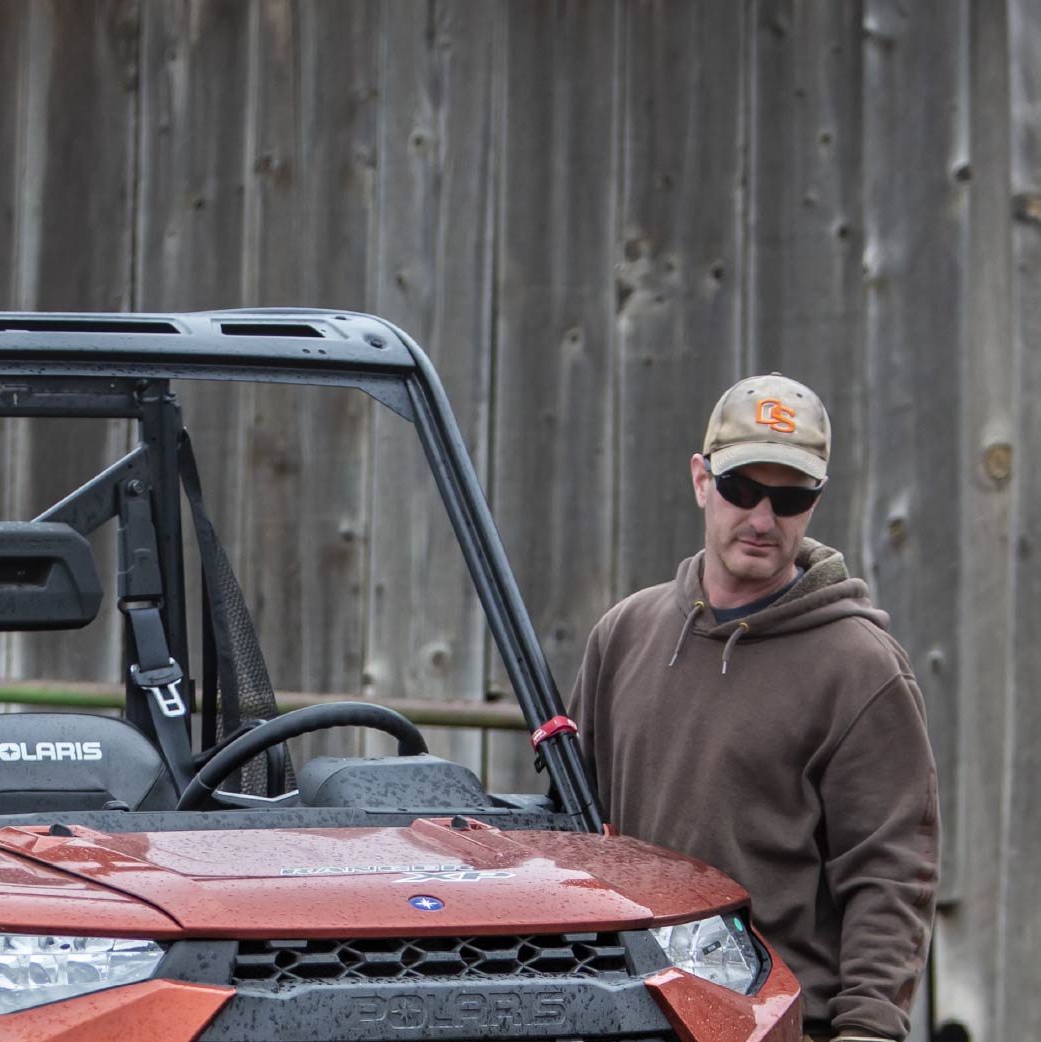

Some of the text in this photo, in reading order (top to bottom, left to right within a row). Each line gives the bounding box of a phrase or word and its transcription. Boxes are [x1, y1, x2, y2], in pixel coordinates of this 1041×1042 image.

[279, 865, 476, 876] RANGER
[391, 870, 516, 883] XP
[350, 992, 567, 1029] POLARIS
